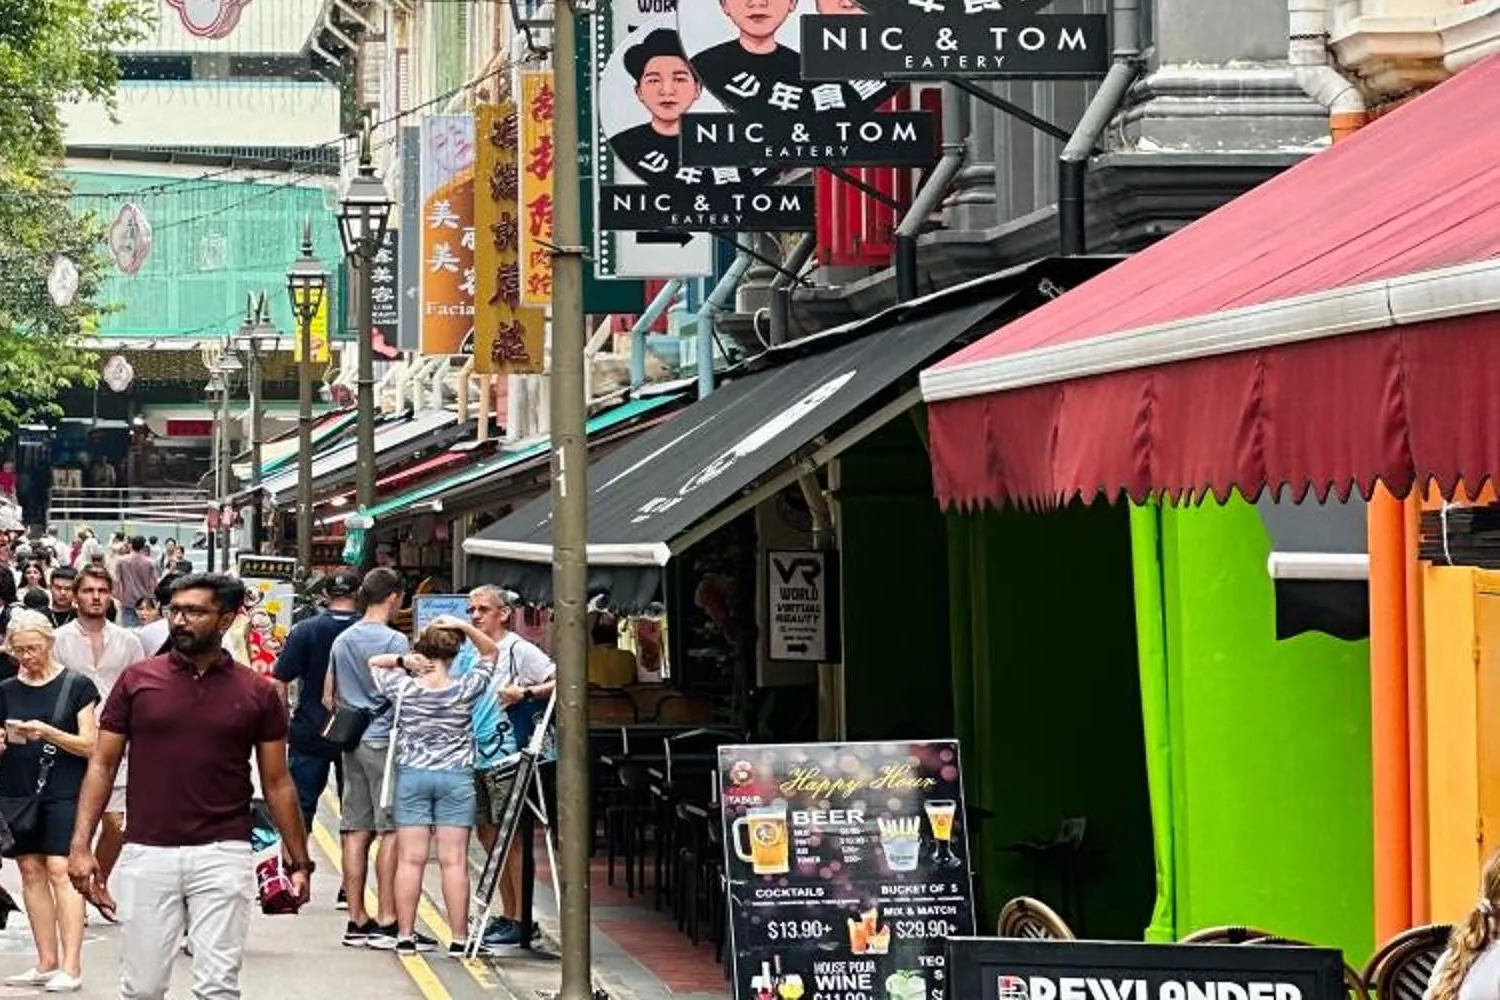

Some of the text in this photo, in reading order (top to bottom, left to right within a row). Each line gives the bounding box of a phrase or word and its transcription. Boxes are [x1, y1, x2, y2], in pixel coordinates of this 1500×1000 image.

[822, 27, 1088, 51] NIC & TOM
[904, 55, 1006, 69] EATERY
[696, 121, 918, 144] NIC & TOM
[764, 145, 850, 157] EATERY
[638, 150, 767, 185] 少年食
[612, 193, 801, 212] NIC & TOM
[670, 214, 745, 225] EATERY
[426, 301, 475, 315] Facia
[771, 557, 821, 588] VR
[780, 587, 819, 601] WORLD
[779, 761, 938, 800] Happy Hour
[792, 809, 865, 826] BEER
[755, 887, 825, 898] COCKTAILS
[881, 885, 927, 895] BUCKET
[929, 884, 946, 894] OF
[883, 906, 957, 917] MIX & MATCH
[767, 920, 833, 940] $13.90+
[896, 919, 958, 940] $29.90+
[815, 974, 873, 991] WINE
